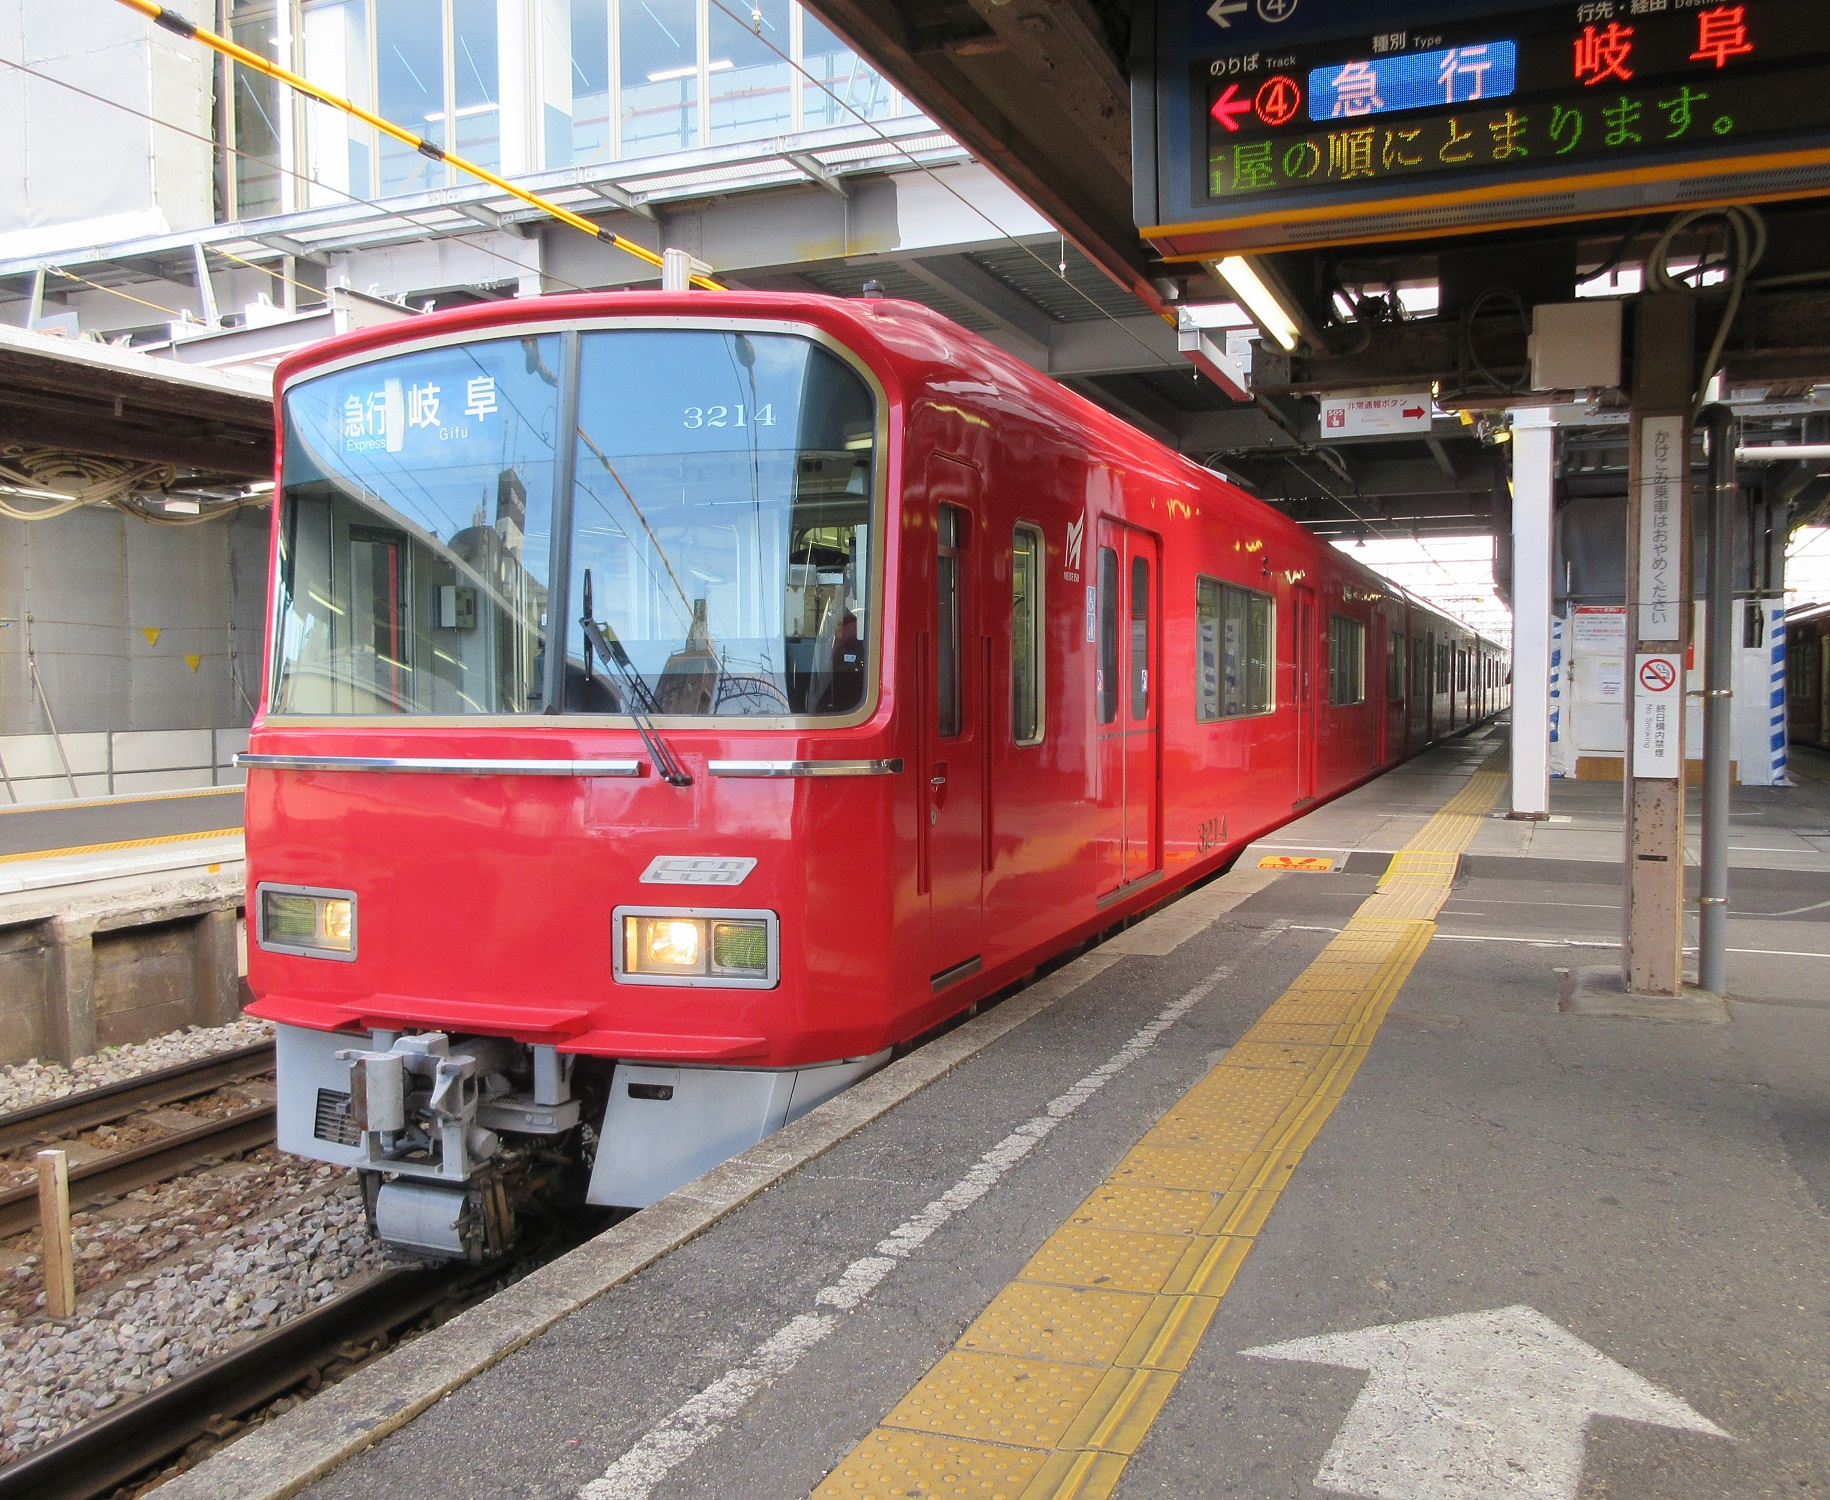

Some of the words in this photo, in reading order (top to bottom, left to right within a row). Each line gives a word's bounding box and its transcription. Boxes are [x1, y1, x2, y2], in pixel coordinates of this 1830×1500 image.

[1372, 31, 1406, 53] 種別
[1413, 34, 1442, 48] Type
[1573, 5, 1755, 86] 岐阜
[1210, 53, 1259, 76] のりば
[1265, 55, 1296, 69] Track
[1331, 46, 1492, 117] 急行
[1209, 86, 1734, 193] 屋の順にとまります。
[344, 391, 387, 437] 急行
[408, 375, 498, 429] 岐阜
[683, 403, 777, 429] 3214
[1347, 399, 1408, 411] 非常通報ボタン
[347, 438, 387, 452] Express
[439, 427, 468, 441] Gifu
[1651, 430, 1669, 624] かけこみ乗車はおやめください
[1645, 704, 1653, 715] No
[1643, 717, 1653, 749] Smoking
[1197, 813, 1228, 853] 3214
